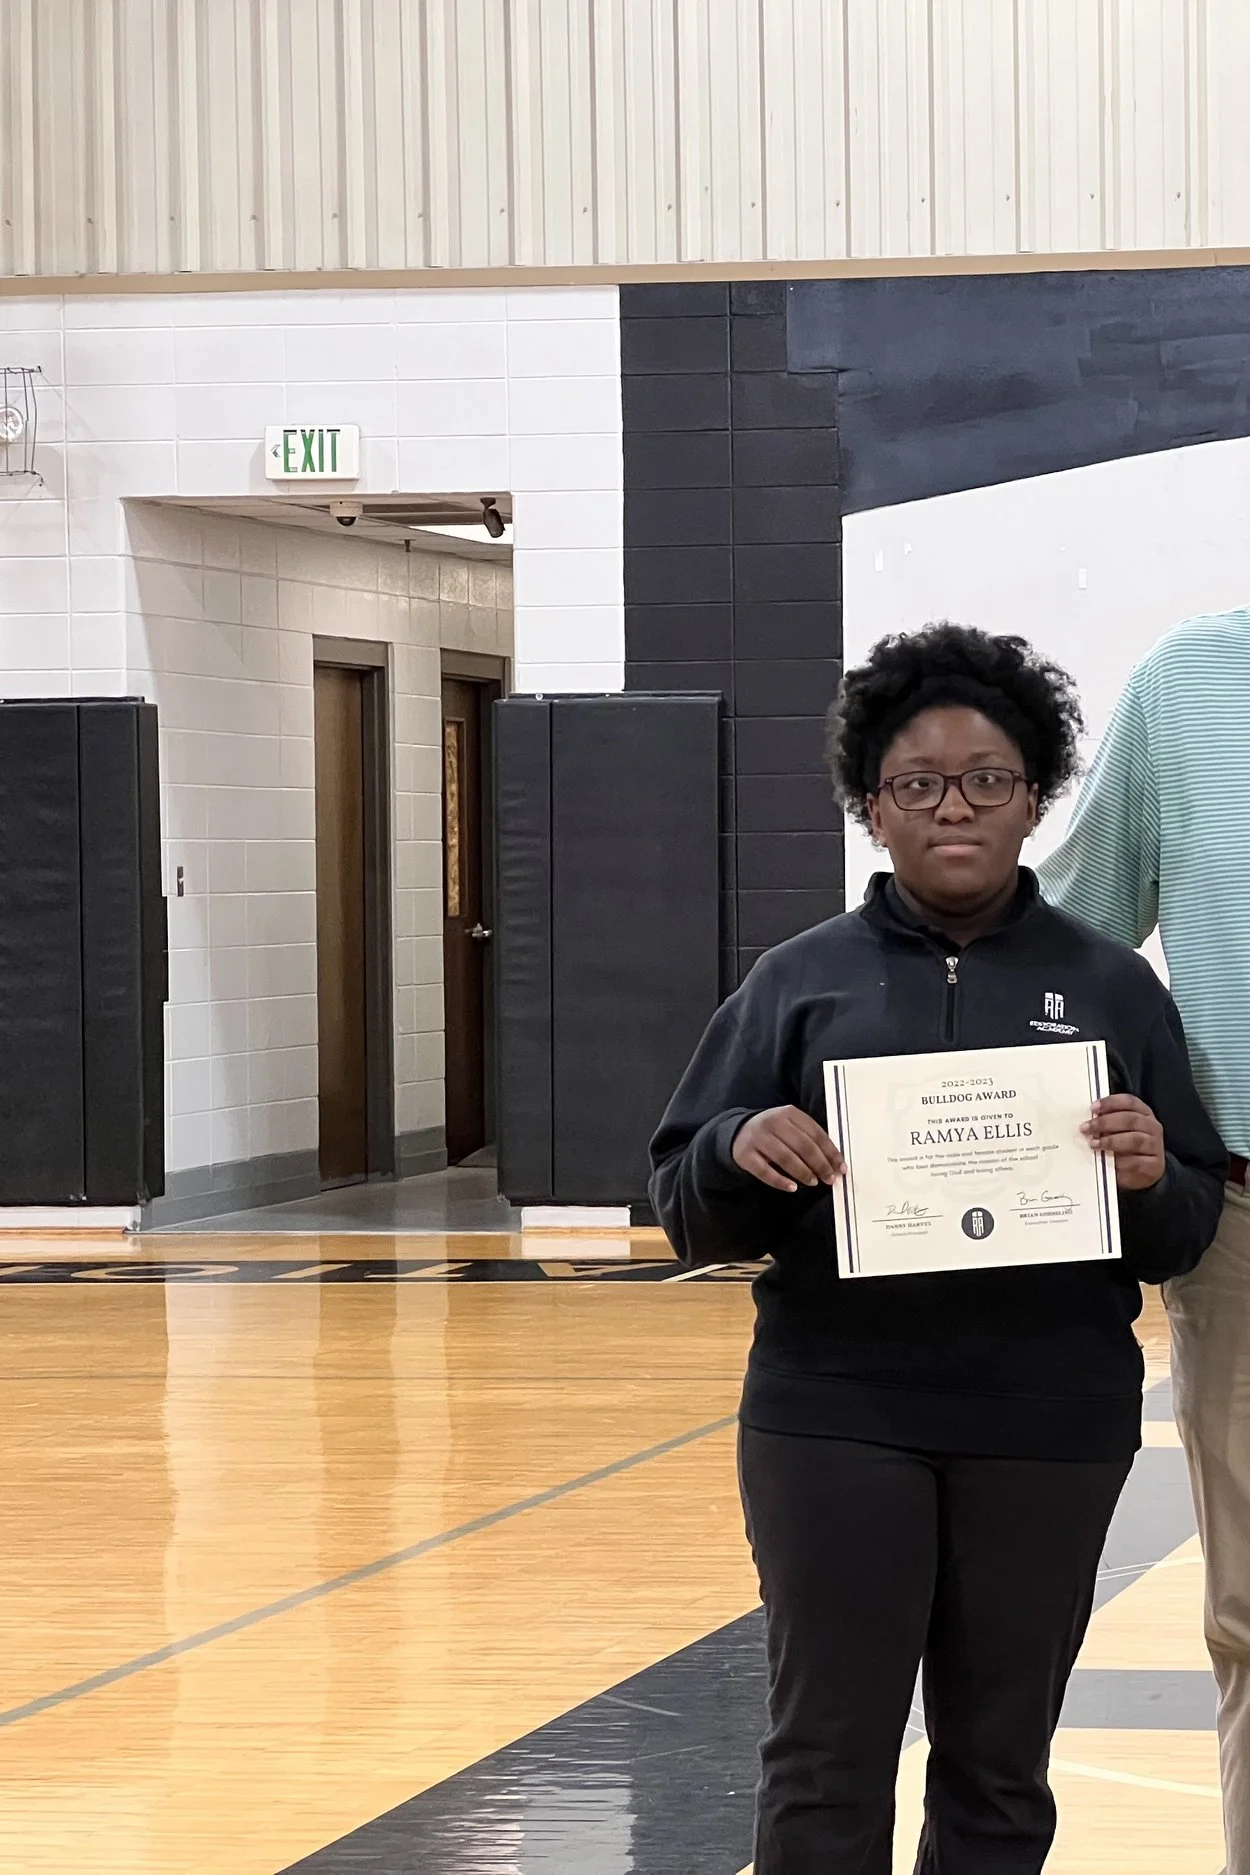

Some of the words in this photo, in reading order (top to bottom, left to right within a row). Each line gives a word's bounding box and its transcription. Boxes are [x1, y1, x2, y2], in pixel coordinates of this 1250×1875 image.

[283, 429, 340, 473] EXIT
[921, 1091, 973, 1106] BULLDOG
[975, 1089, 1017, 1101] AWARD
[910, 1126, 979, 1146] RAMYA
[984, 1122, 1033, 1140] ELLIS
